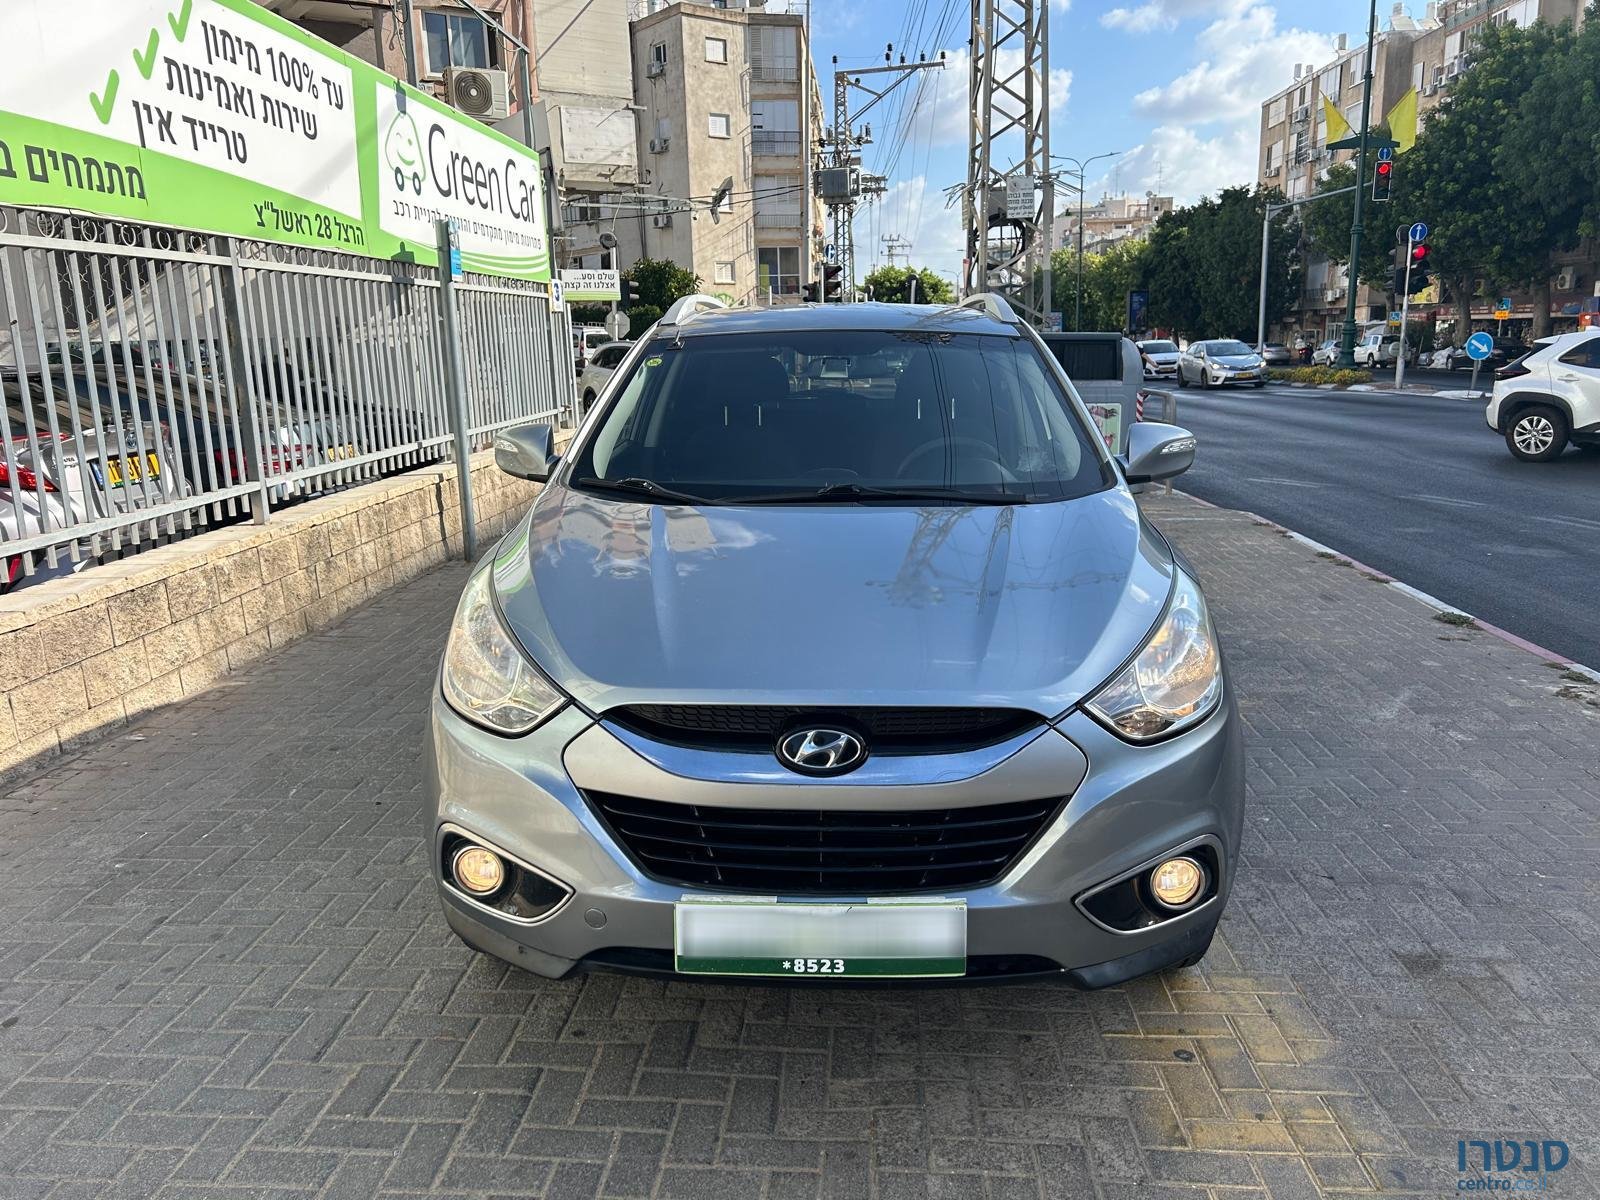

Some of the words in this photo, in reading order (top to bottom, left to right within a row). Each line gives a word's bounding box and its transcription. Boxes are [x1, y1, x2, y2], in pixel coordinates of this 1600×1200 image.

[200, 19, 261, 75] מימון
[163, 55, 257, 120] ואמינות
[268, 47, 320, 100] 100%
[322, 76, 345, 111] עד
[131, 99, 178, 149] אין
[259, 93, 318, 141] שירות
[181, 115, 248, 164] טרייד
[24, 144, 147, 200] מתמחים
[428, 123, 503, 214] Green
[505, 158, 536, 224] Car
[314, 214, 332, 240] 28
[392, 200, 412, 219] רכב
[333, 219, 365, 247] הרצל
[564, 281, 581, 291] קצת
[583, 281, 592, 289] זה
[594, 280, 616, 289] אצלנו
[597, 272, 615, 281] שלם
